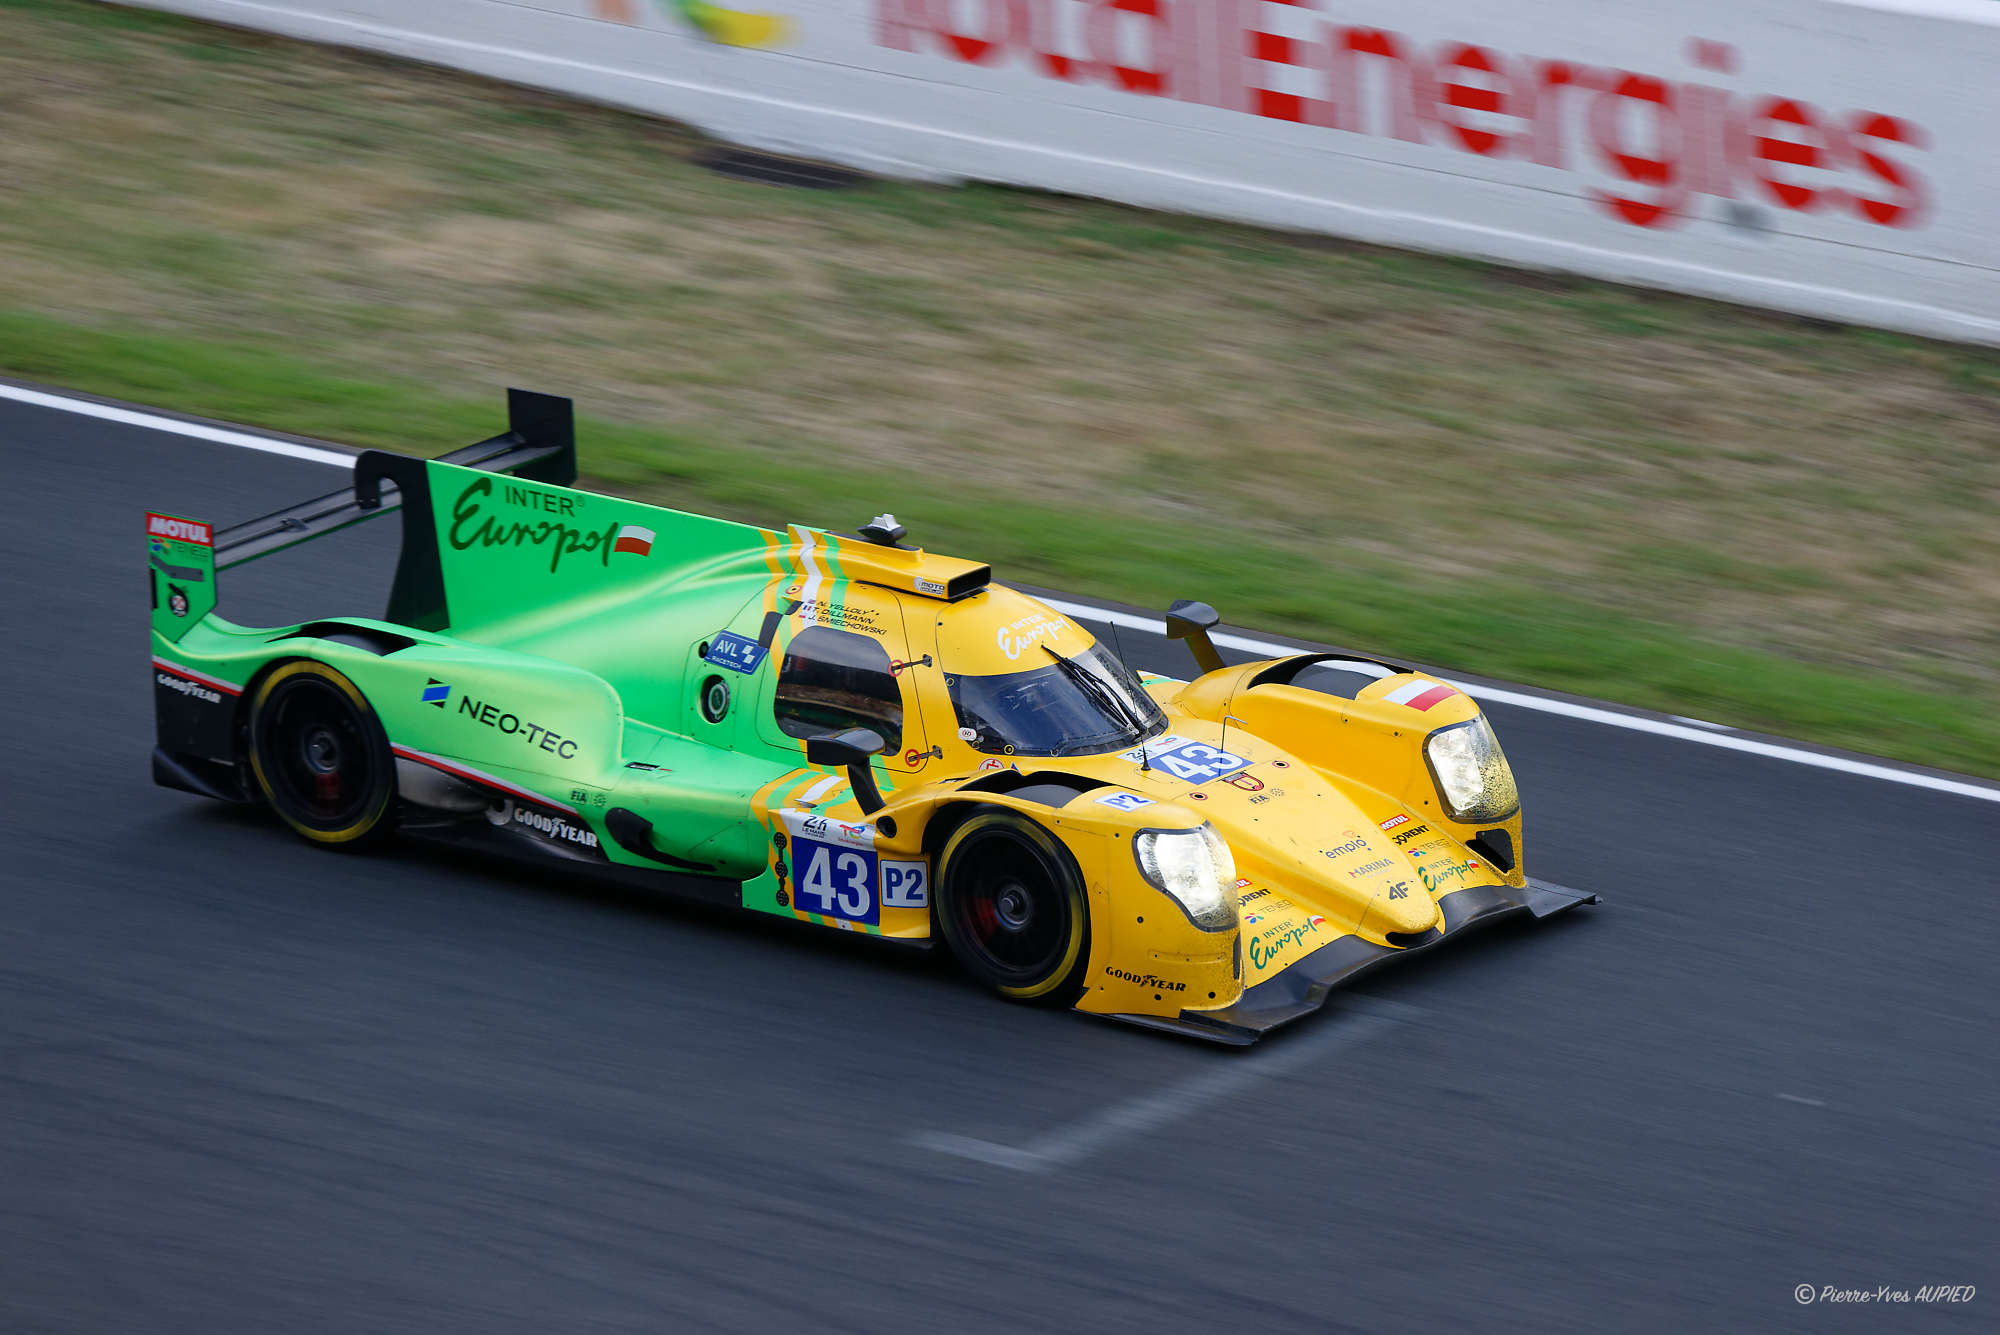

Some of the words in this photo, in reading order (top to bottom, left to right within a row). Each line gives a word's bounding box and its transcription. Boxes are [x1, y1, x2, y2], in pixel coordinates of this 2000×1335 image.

[505, 486, 575, 517] INTER
[150, 517, 209, 543] MOTUL
[450, 477, 619, 573] Europol
[817, 615, 887, 635] SMIECHOWSKI
[822, 609, 874, 624] DILLMANN
[715, 640, 738, 657] AVL
[459, 695, 578, 760] NEO-TEC
[1159, 745, 1243, 779] 43
[571, 790, 588, 804] FIA
[1104, 794, 1150, 809] P2
[1250, 794, 1269, 804] FIA
[514, 808, 598, 848] GOODYEAR
[1325, 837, 1367, 860] emplo
[803, 846, 870, 917] 43
[1348, 858, 1395, 879] MARINA
[1418, 859, 1475, 893] Europol
[885, 867, 924, 901] P2
[1389, 881, 1409, 900] 4F
[1264, 920, 1294, 940] INTER
[1250, 918, 1317, 970] Europol
[1106, 966, 1187, 992] GOODYEAR
